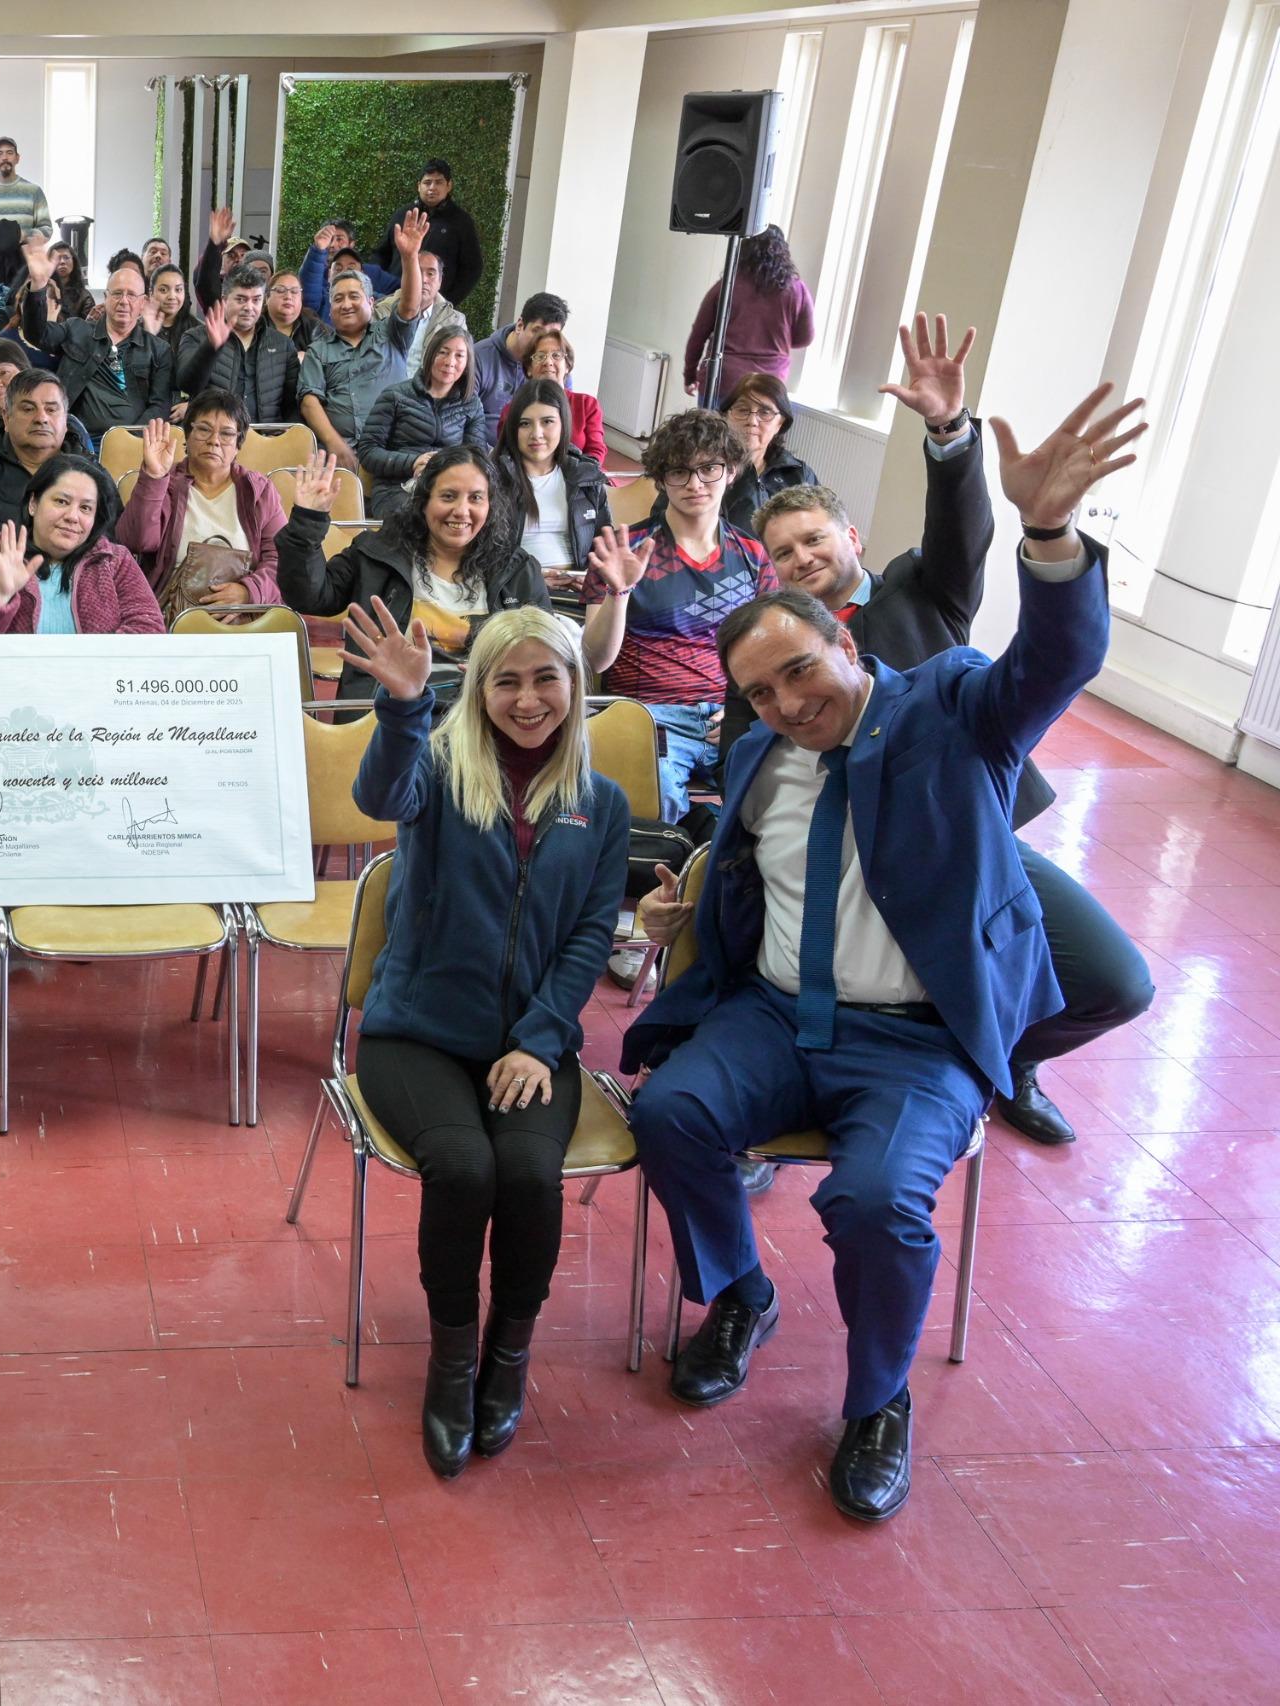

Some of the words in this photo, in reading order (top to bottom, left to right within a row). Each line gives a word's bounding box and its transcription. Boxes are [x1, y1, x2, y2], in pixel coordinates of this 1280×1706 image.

[116, 679, 239, 694] $1.496.000.000
[134, 699, 159, 707] Arenas,
[181, 698, 215, 706] Diciembre
[216, 698, 225, 706] de
[46, 728, 63, 742] de
[68, 727, 83, 742] la
[91, 726, 142, 746] Región
[146, 728, 164, 741] de
[168, 726, 258, 746] Magallanes
[3, 774, 57, 788] noventa
[62, 777, 73, 791] y
[77, 774, 105, 787] seis
[110, 772, 169, 787] millones
[555, 817, 587, 829] INDESPA
[5, 843, 40, 851] Magallanes
[155, 841, 183, 849] Regional
